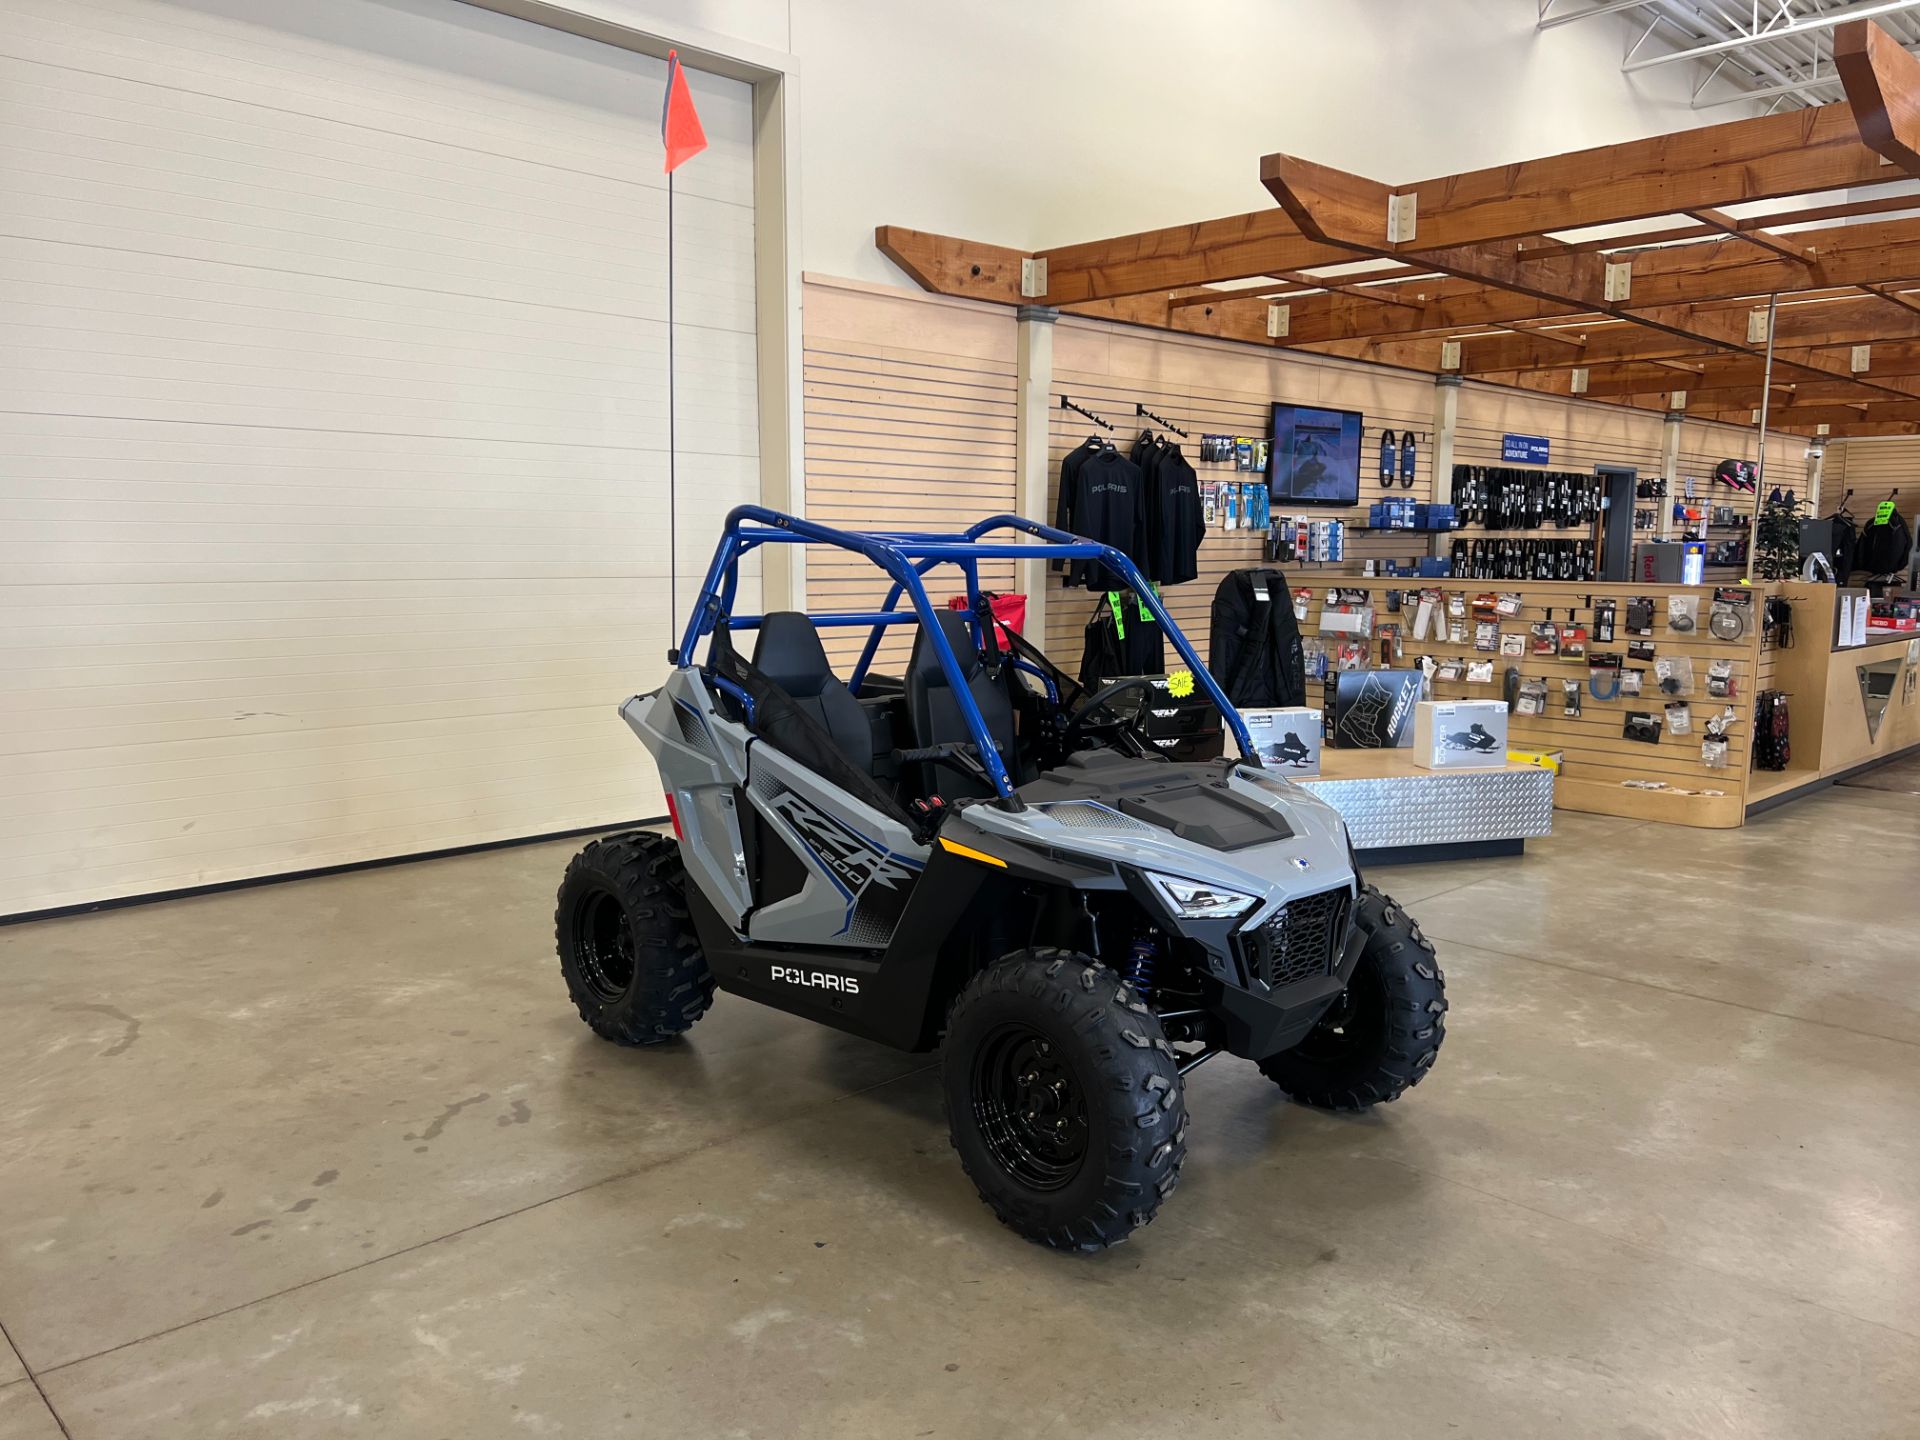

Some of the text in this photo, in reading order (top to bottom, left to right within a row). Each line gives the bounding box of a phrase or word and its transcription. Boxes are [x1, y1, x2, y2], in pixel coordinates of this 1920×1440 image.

[1505, 450, 1528, 459] ADVENTURE
[1091, 482, 1128, 494] POLARIS
[1643, 554, 1657, 578] Red
[1170, 676, 1190, 690] SALE
[1151, 708, 1180, 718] FLY
[1387, 675, 1411, 738] ROCKET
[1152, 738, 1181, 748] FLY
[1439, 725, 1447, 764] COVER
[768, 790, 913, 892] RZR
[820, 849, 865, 885] 200
[770, 965, 860, 994] POLARIS
